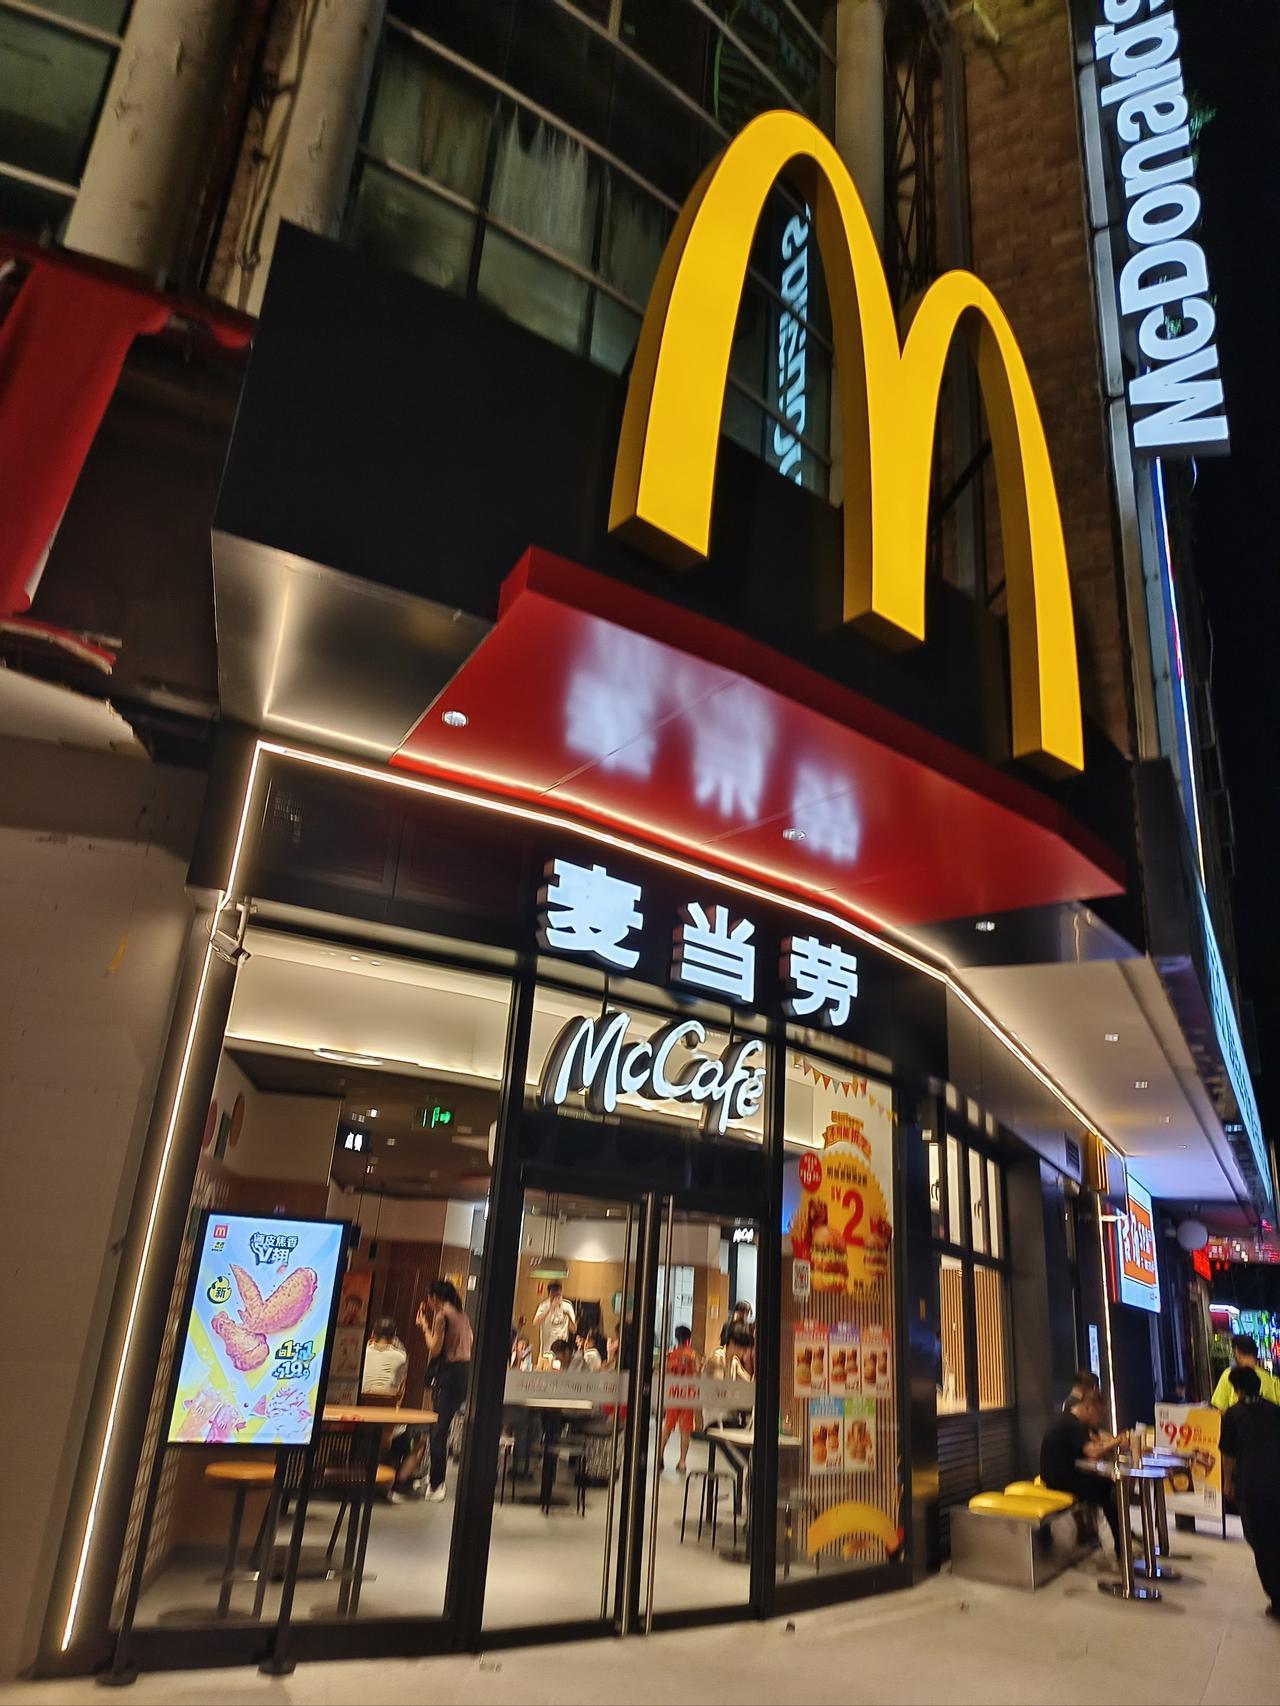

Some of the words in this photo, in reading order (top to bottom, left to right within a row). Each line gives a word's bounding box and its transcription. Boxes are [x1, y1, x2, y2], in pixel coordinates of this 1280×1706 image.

[545, 858, 859, 1027] 麦当劳
[550, 1009, 767, 1136] McCafé
